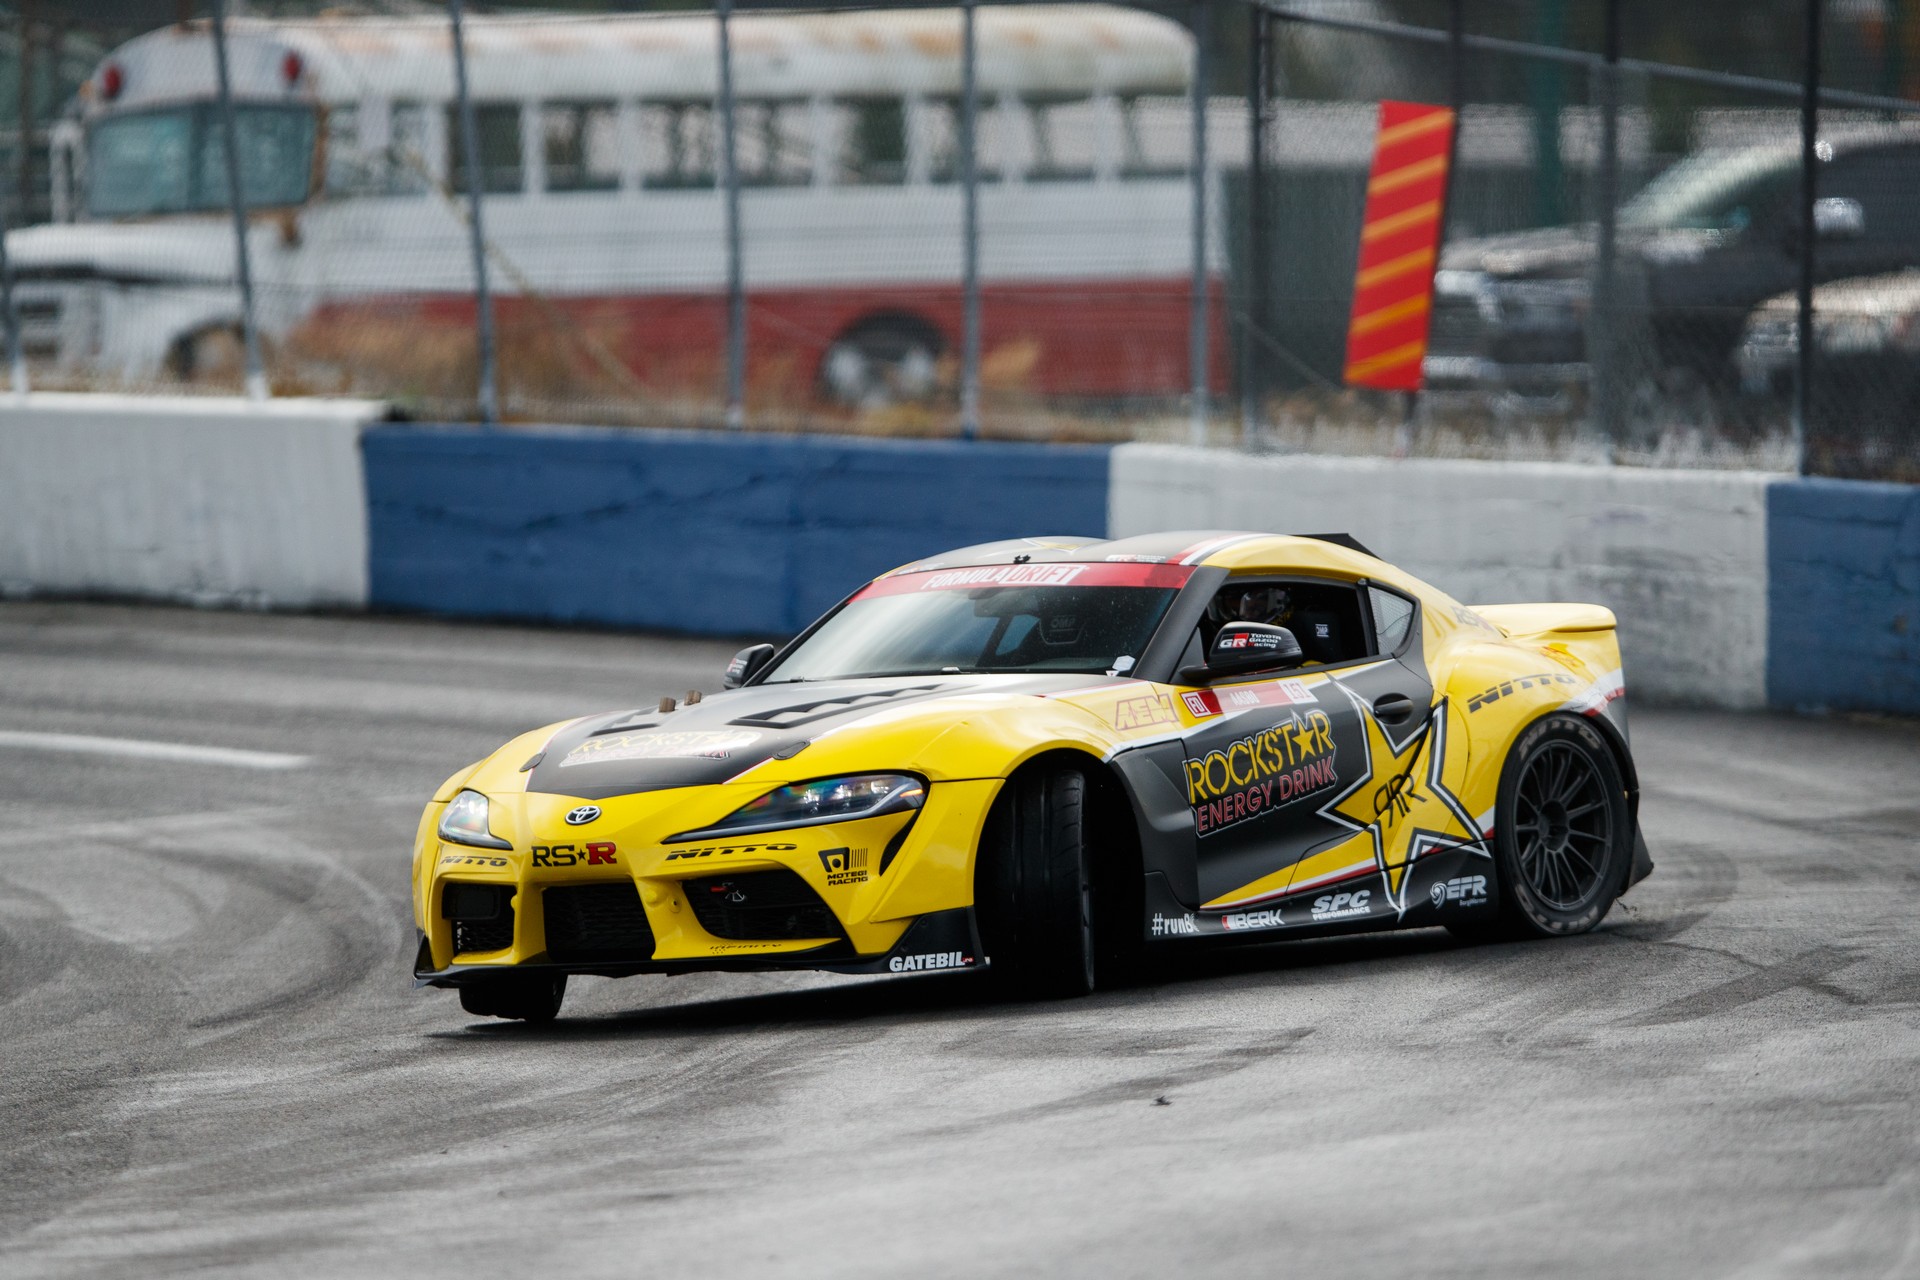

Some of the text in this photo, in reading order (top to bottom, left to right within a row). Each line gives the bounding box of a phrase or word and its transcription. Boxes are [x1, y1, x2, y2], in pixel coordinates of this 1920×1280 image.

[1219, 638, 1248, 649] GR
[1467, 673, 1576, 713] NITTO
[1115, 693, 1179, 731] AEM
[1197, 756, 1336, 832] ENERGY DRINK
[440, 855, 508, 867] NITTO
[665, 843, 797, 861] NITTO
[827, 870, 867, 879] MOTEGI
[828, 877, 868, 886] RACING
[1446, 874, 1487, 899] EFR
[1311, 889, 1371, 913] SPC
[1234, 909, 1285, 930] BERK
[1312, 905, 1371, 921] PERFORMANCE
[889, 951, 966, 972] GATEBIL
